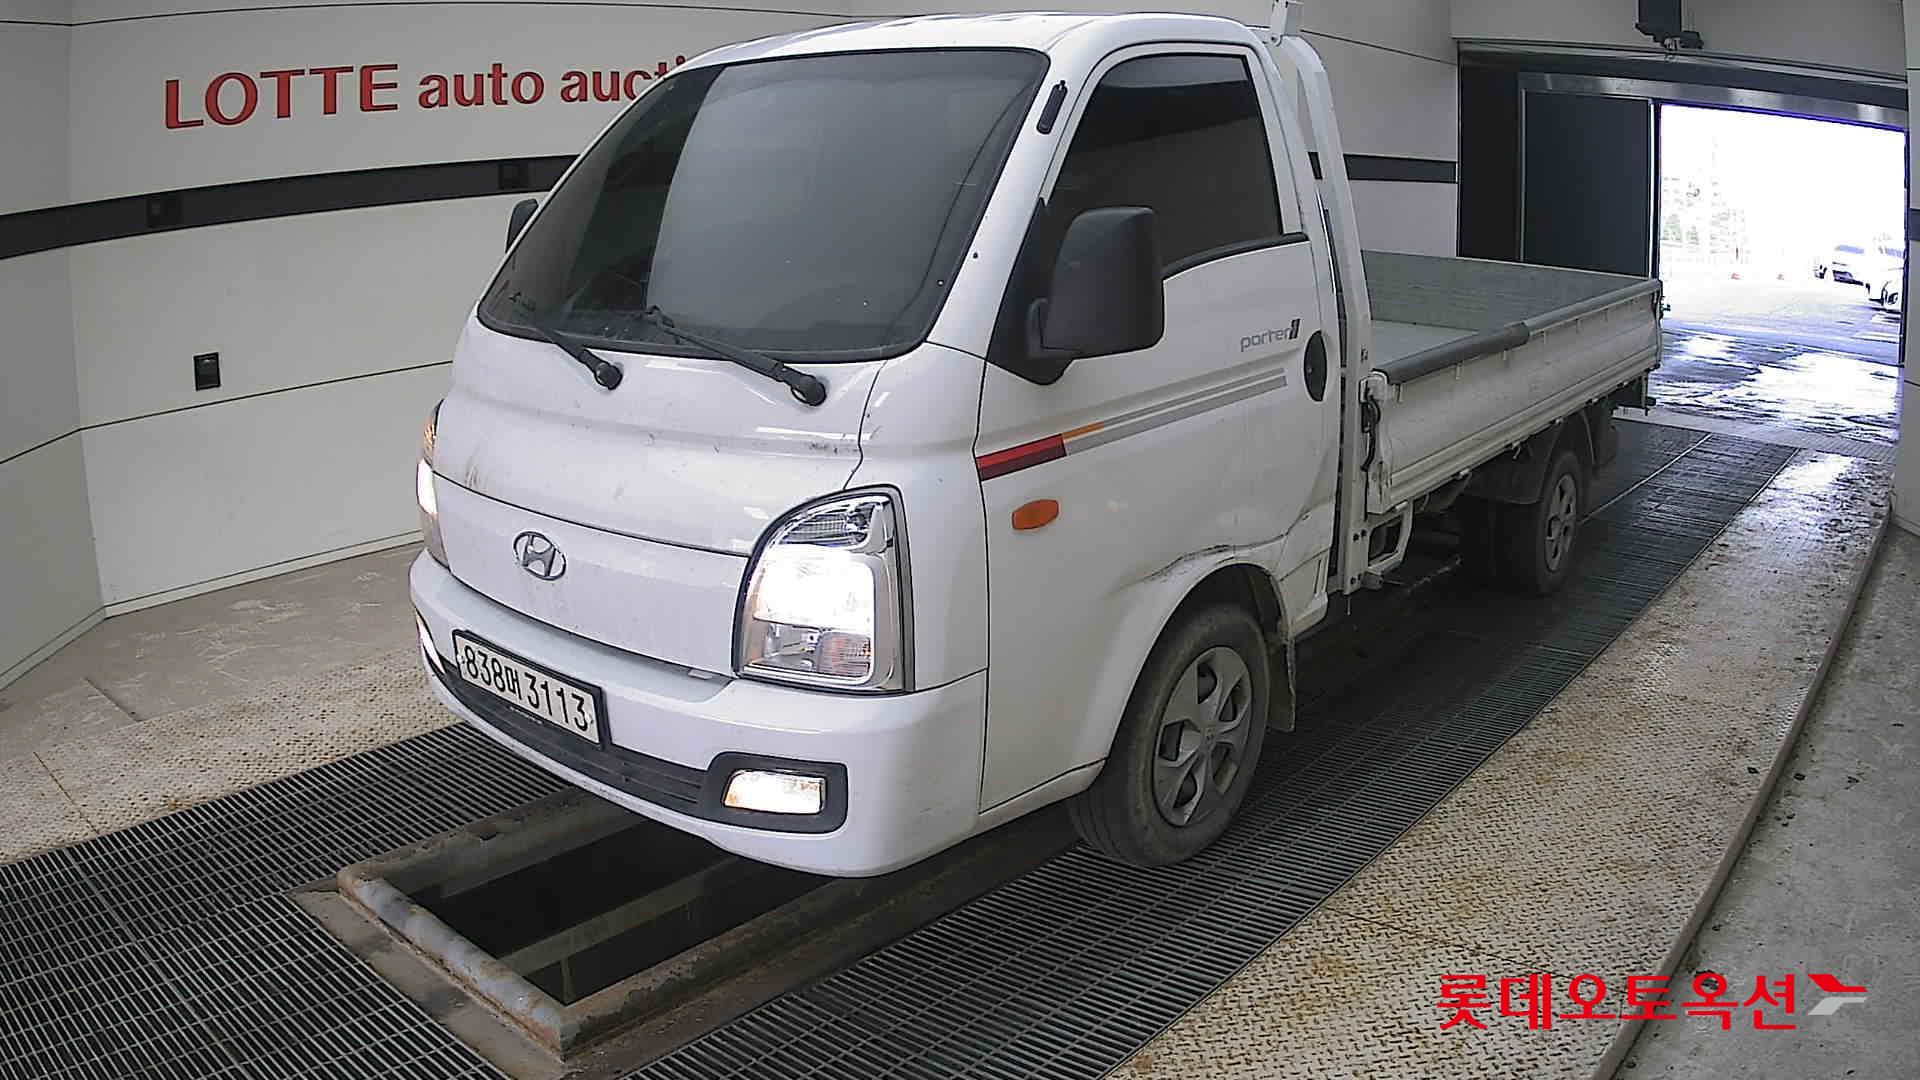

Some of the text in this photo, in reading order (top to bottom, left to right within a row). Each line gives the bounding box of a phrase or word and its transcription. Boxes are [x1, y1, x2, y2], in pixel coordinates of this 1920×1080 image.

[164, 63, 399, 130] LOTTE
[417, 62, 546, 109] auto
[524, 672, 588, 732] 3113
